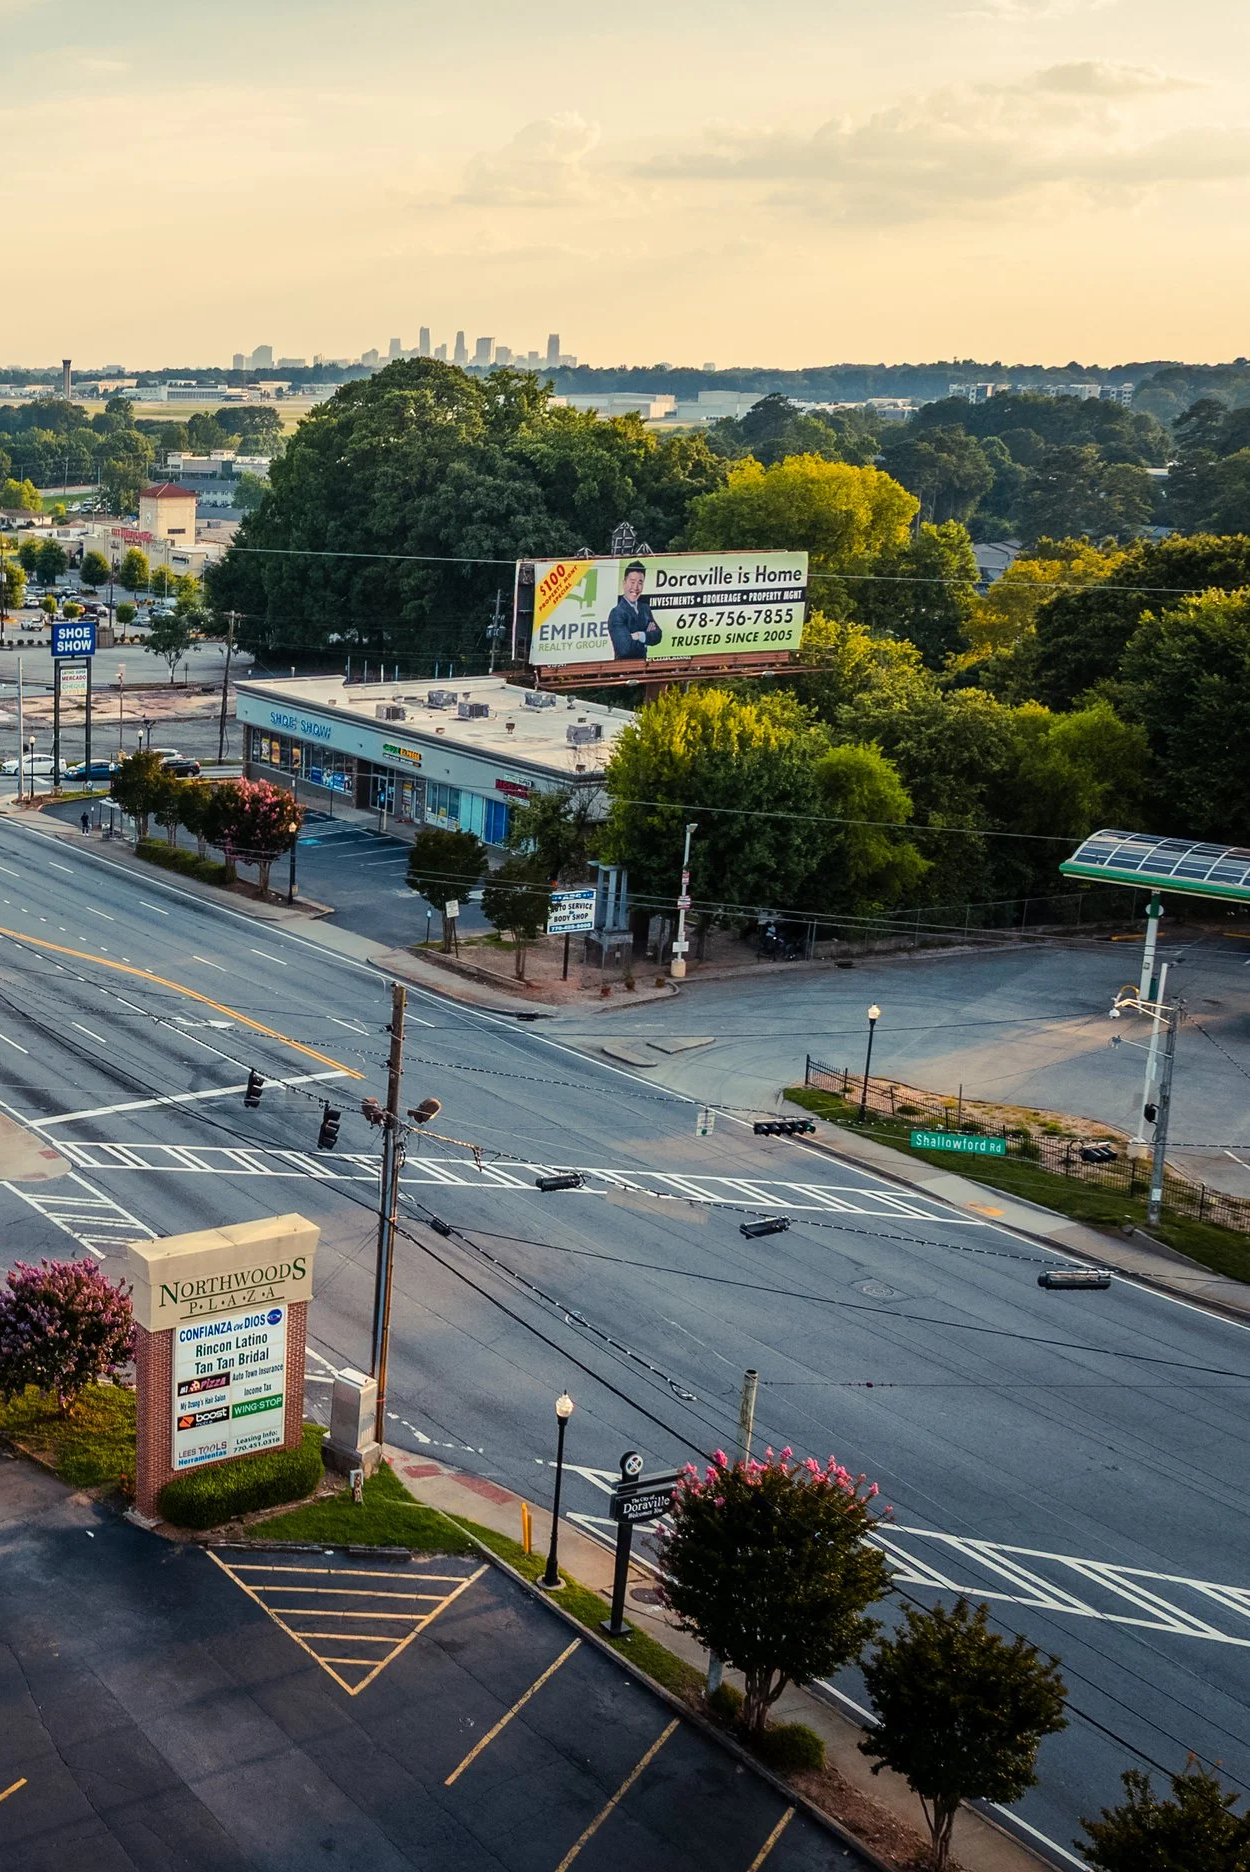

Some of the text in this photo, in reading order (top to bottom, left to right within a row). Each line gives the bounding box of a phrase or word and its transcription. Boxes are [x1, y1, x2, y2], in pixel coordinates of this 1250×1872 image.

[540, 564, 566, 596] $100
[655, 565, 802, 588] Doraville is Home
[539, 583, 563, 611] PROPERTY
[553, 583, 572, 605] SPECIAL
[649, 594, 695, 607] INVESTMENTS
[702, 592, 741, 605] BROKERAGE
[749, 590, 782, 602] PROPERTY
[676, 608, 793, 629] 678-756-7855
[58, 627, 90, 639] SHOE
[539, 621, 609, 641] EMPIRE
[671, 629, 793, 647] TRUSTED SINCE 2005
[57, 640, 92, 652] SHOW
[538, 639, 608, 652] REALTY GROUP
[270, 711, 298, 730] SHOE
[568, 902, 593, 911] SERVICE
[553, 912, 589, 923] BODY SHOP
[916, 1134, 1001, 1152] Shallowford Rd
[158, 1257, 306, 1307] NORTHWOODS
[179, 1314, 266, 1342] CONFIANZA en DIOS
[195, 1333, 268, 1357] Rincon Latino
[194, 1347, 269, 1375] Tan Tan Bridal
[232, 1363, 284, 1381] Auto Town Insurance
[244, 1383, 272, 1397] Income Tax
[204, 1396, 214, 1405] Hair
[214, 1394, 226, 1403] Salon
[195, 1408, 228, 1422] boost
[236, 1430, 278, 1445] Leasing Info:
[178, 1441, 228, 1458] LEES TOOLS
[178, 1450, 227, 1466] Herramientas
[623, 1495, 670, 1514] Doraville
